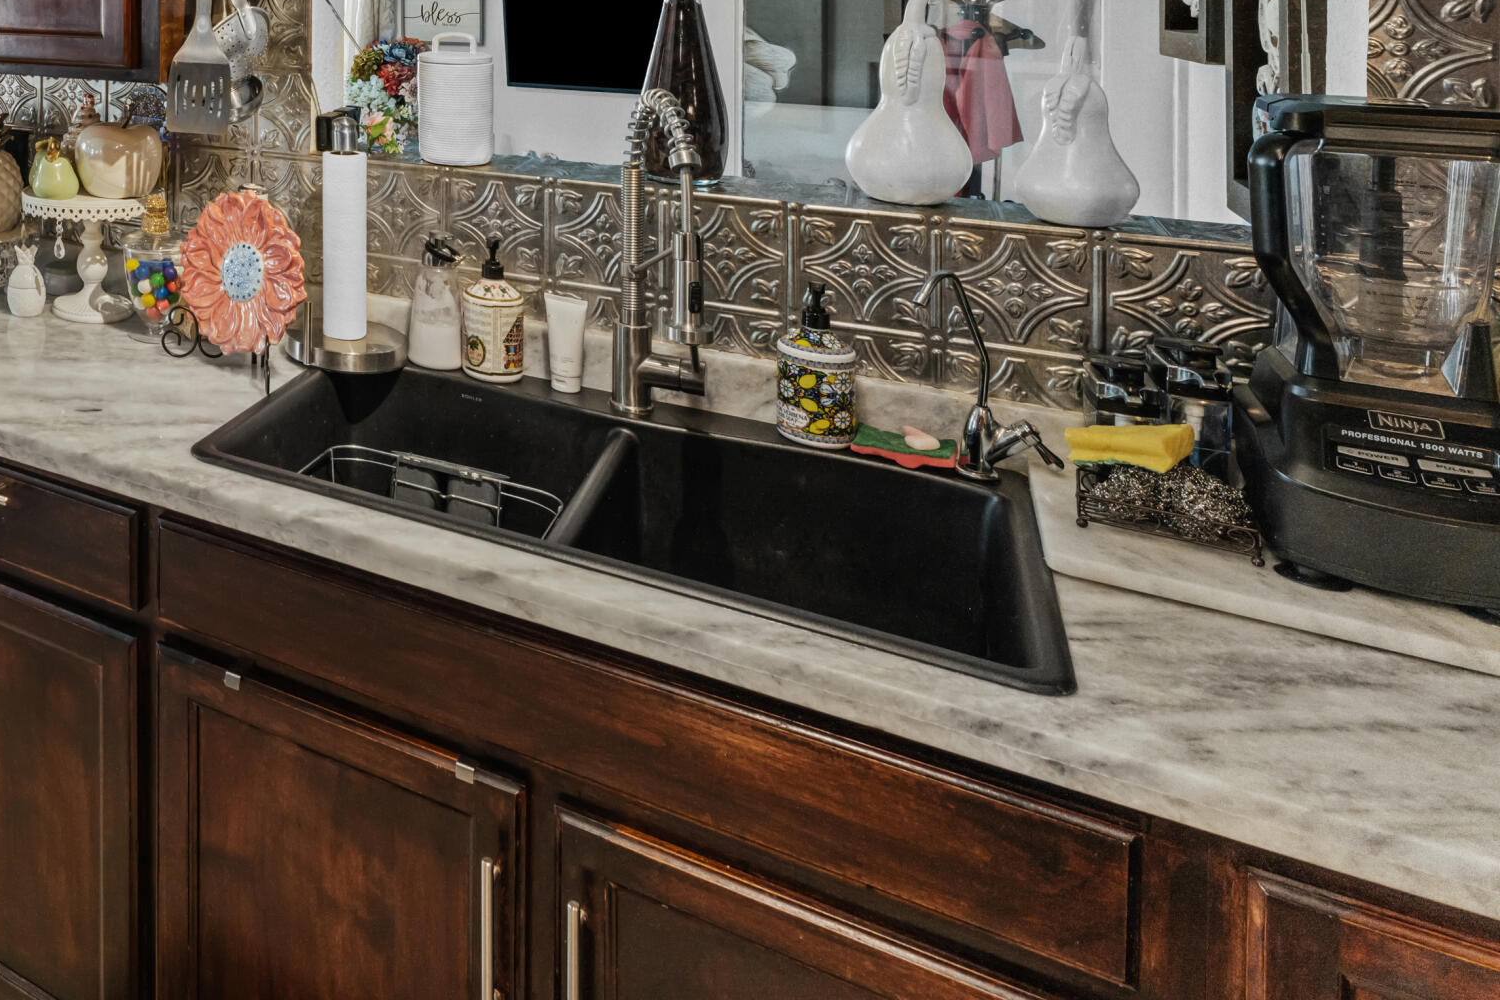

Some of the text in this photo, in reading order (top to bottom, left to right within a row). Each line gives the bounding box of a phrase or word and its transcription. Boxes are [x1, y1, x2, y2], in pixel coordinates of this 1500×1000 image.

[420, 1, 462, 26] bless
[1377, 412, 1433, 433] NINJA
[1341, 429, 1484, 459] PROFESSIONAL 1500 WATTS
[1357, 450, 1399, 462] POWER
[1435, 463, 1476, 476] PULSE
